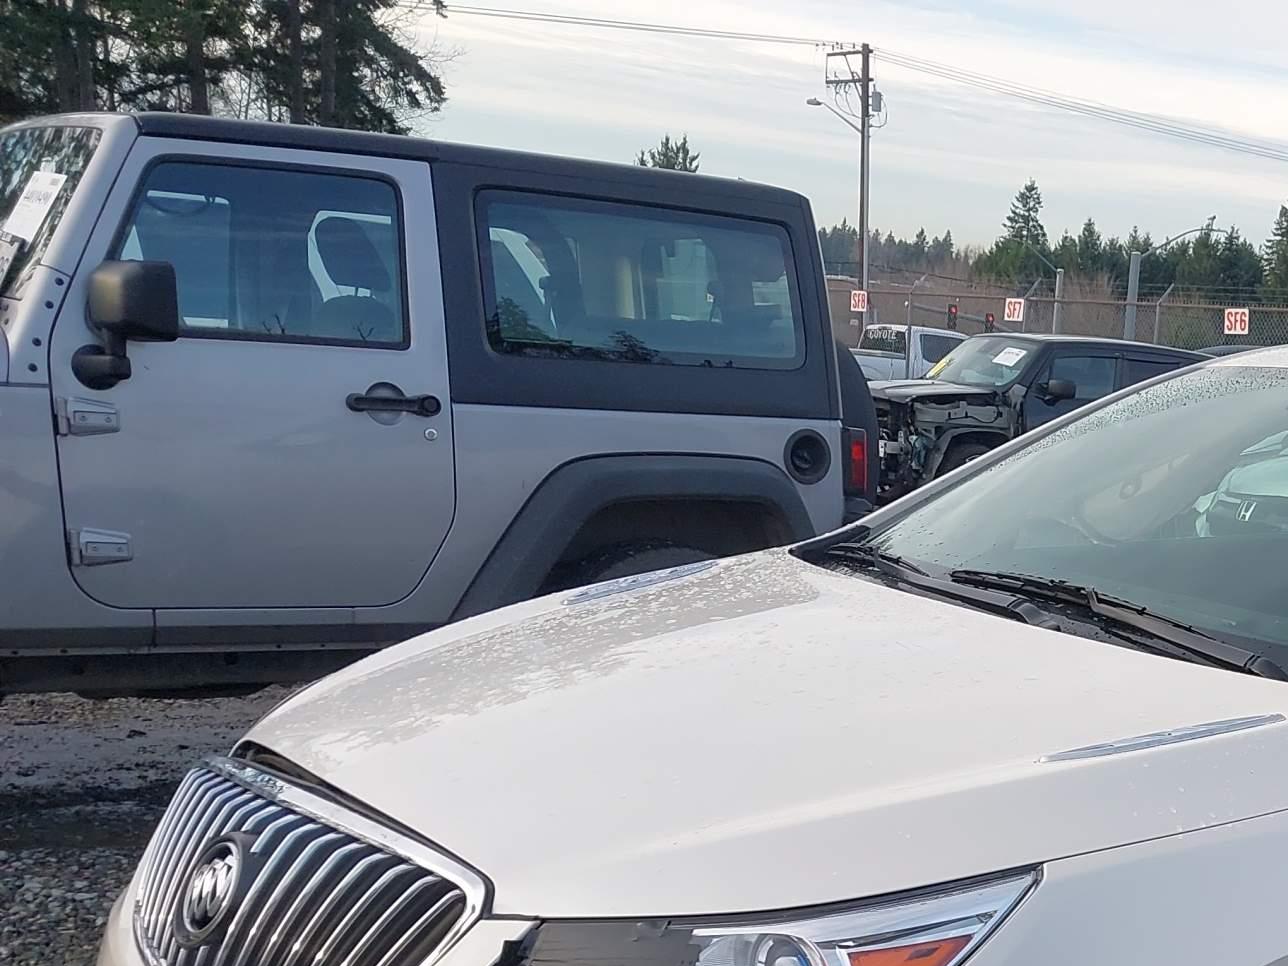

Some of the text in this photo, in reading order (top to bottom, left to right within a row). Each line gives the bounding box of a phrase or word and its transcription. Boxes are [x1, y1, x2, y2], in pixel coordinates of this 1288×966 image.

[853, 292, 866, 309] SF8
[1007, 301, 1022, 319] SF7
[1226, 311, 1247, 331] SF6
[869, 329, 897, 340] COYOTE
